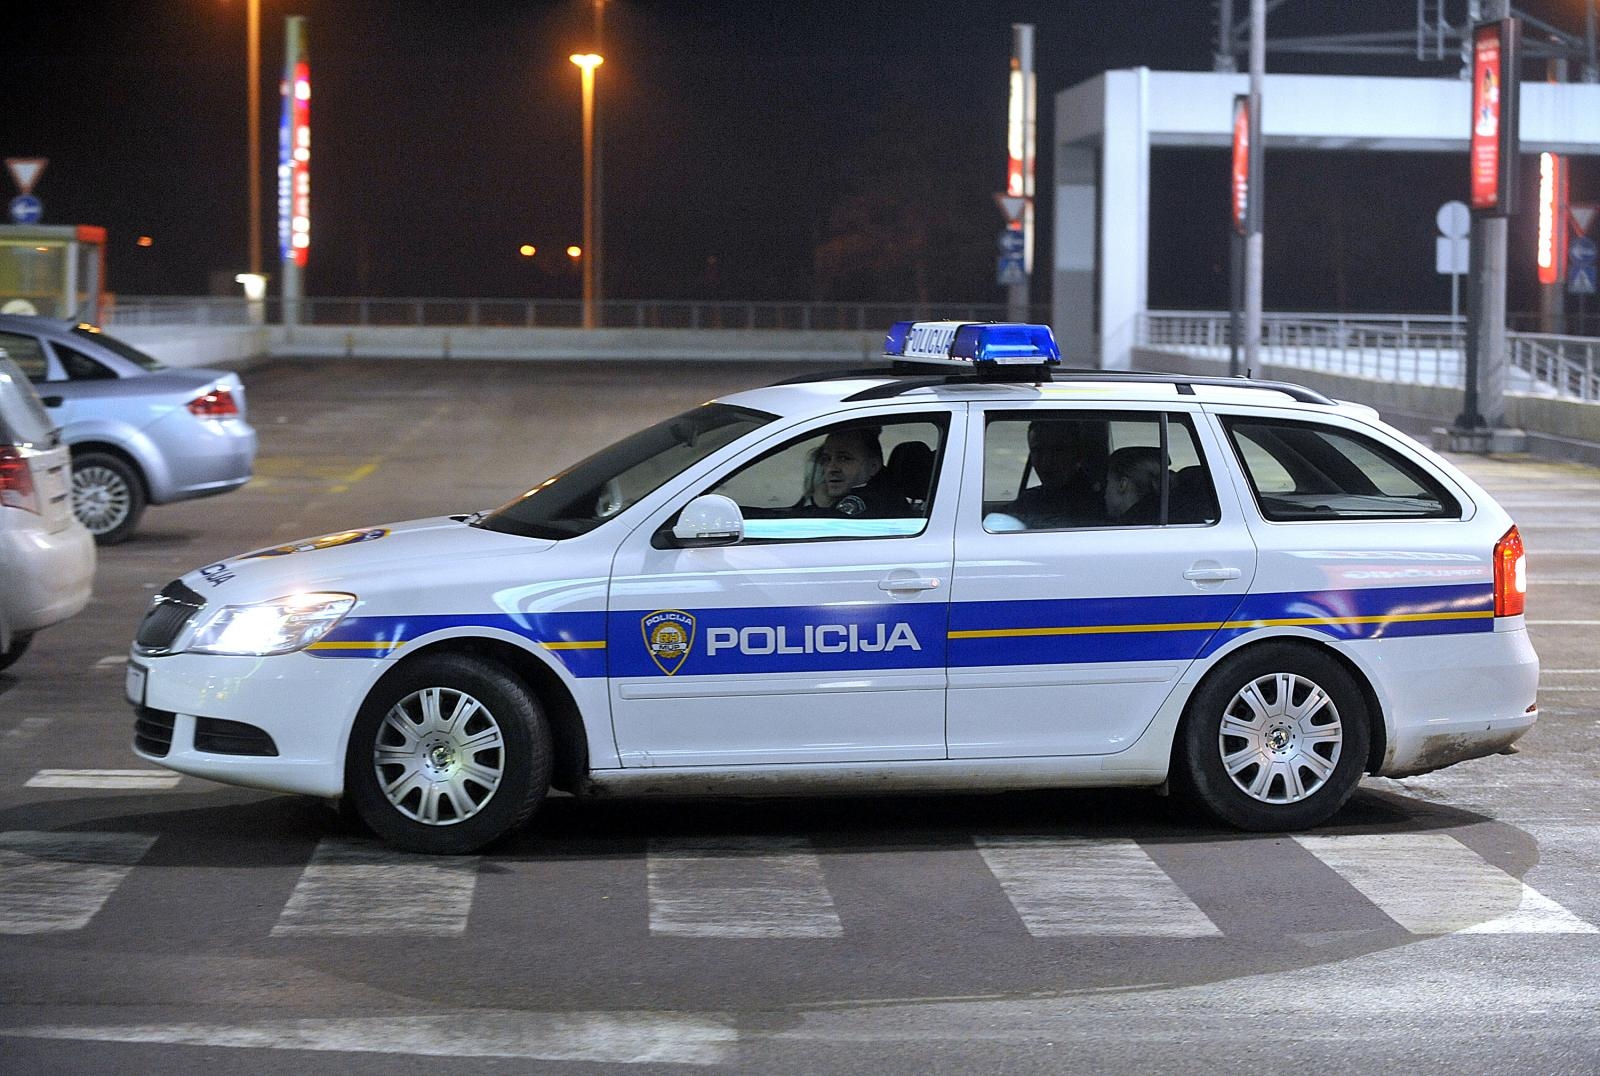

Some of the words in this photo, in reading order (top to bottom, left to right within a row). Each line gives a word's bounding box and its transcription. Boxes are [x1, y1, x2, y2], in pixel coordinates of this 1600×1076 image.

[645, 613, 693, 627] POLICIJA
[707, 622, 922, 656] POLICIJA
[658, 643, 681, 651] MUP
